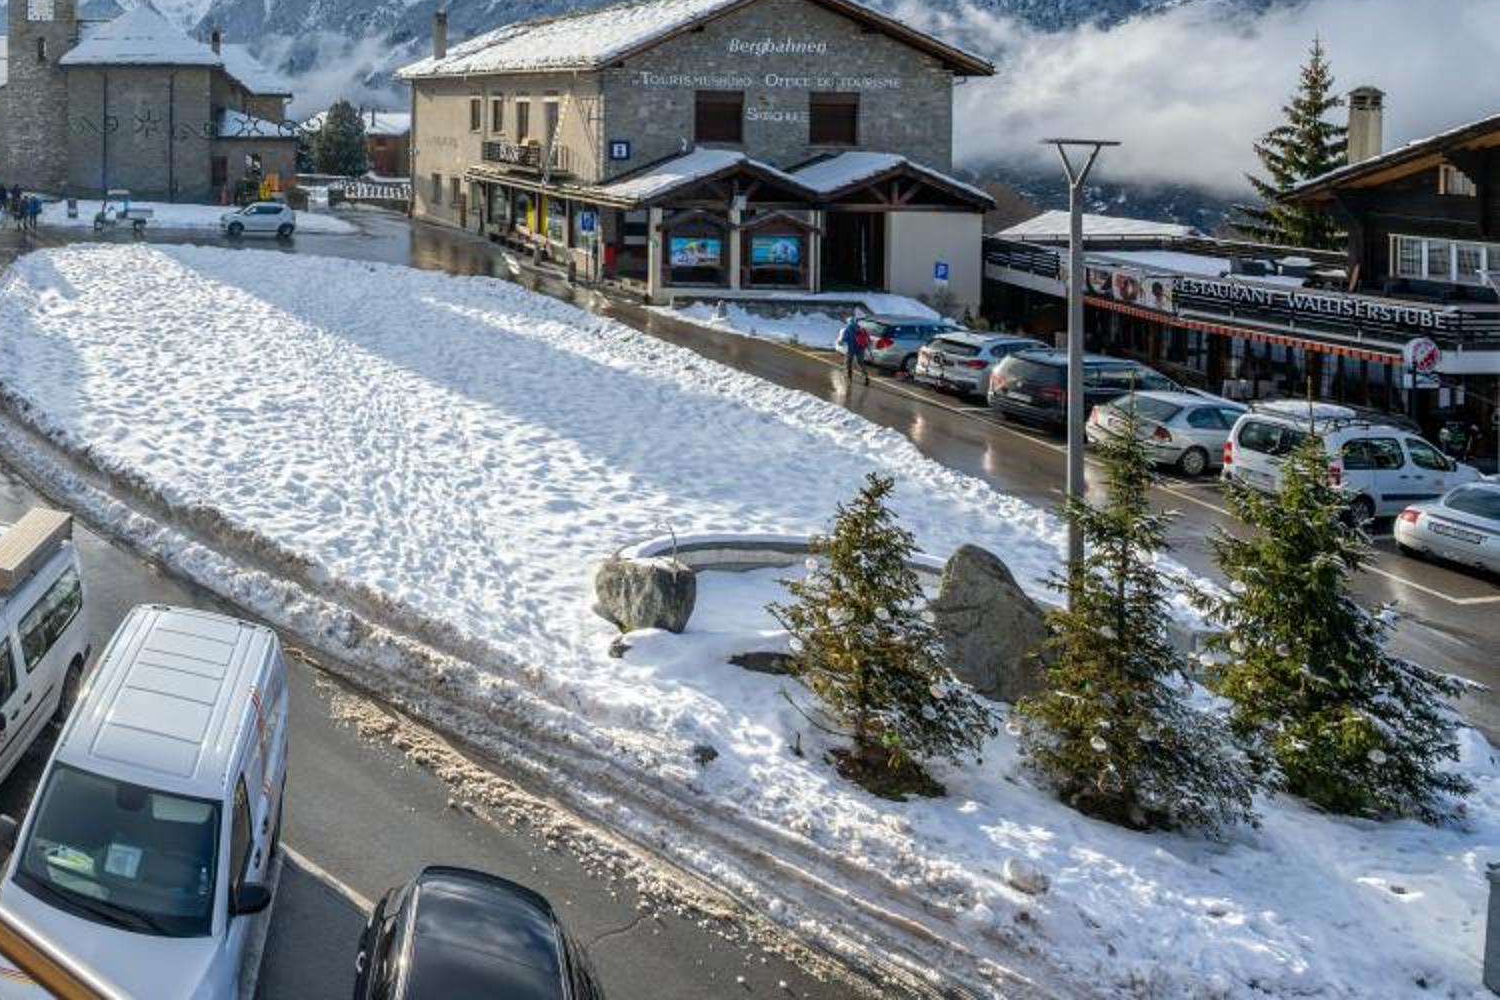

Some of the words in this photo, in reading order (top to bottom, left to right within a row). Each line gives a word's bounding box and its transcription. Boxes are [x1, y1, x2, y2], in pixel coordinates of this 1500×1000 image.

[729, 38, 827, 56] Bergbahnen
[1173, 278, 1274, 304] RESTAURANT
[1285, 292, 1447, 330] WALLISERSTUBE
